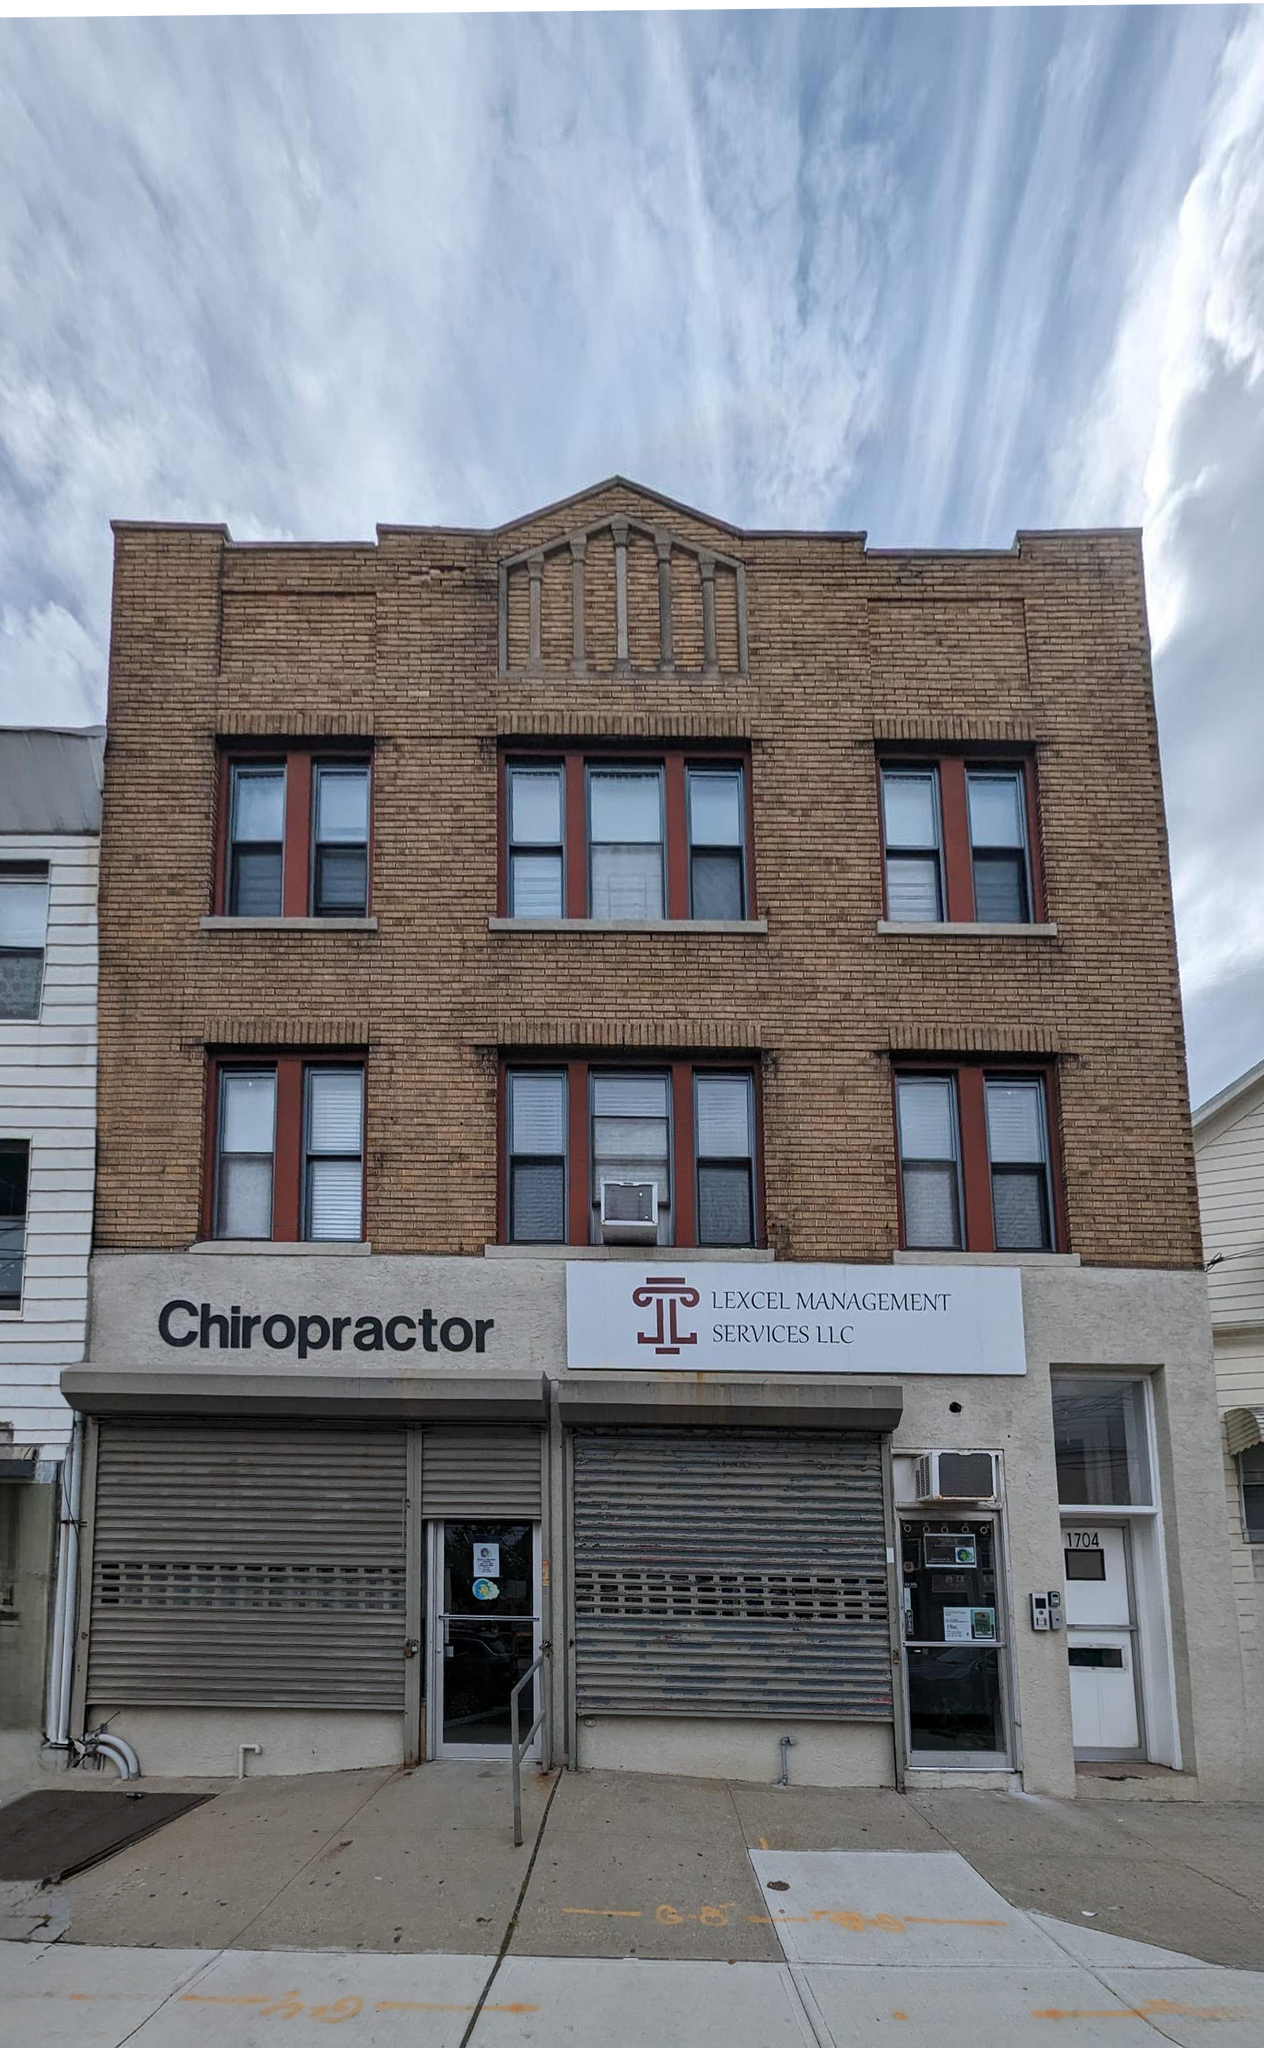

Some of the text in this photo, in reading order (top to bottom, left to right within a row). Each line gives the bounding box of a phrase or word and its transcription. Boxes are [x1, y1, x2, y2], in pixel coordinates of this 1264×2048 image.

[711, 1291, 952, 1312] LEXCEL MANAGEMENT
[158, 1299, 495, 1359] Chiropractor
[712, 1324, 855, 1345] SERVICES LLC
[1066, 1532, 1100, 1548] 1704
